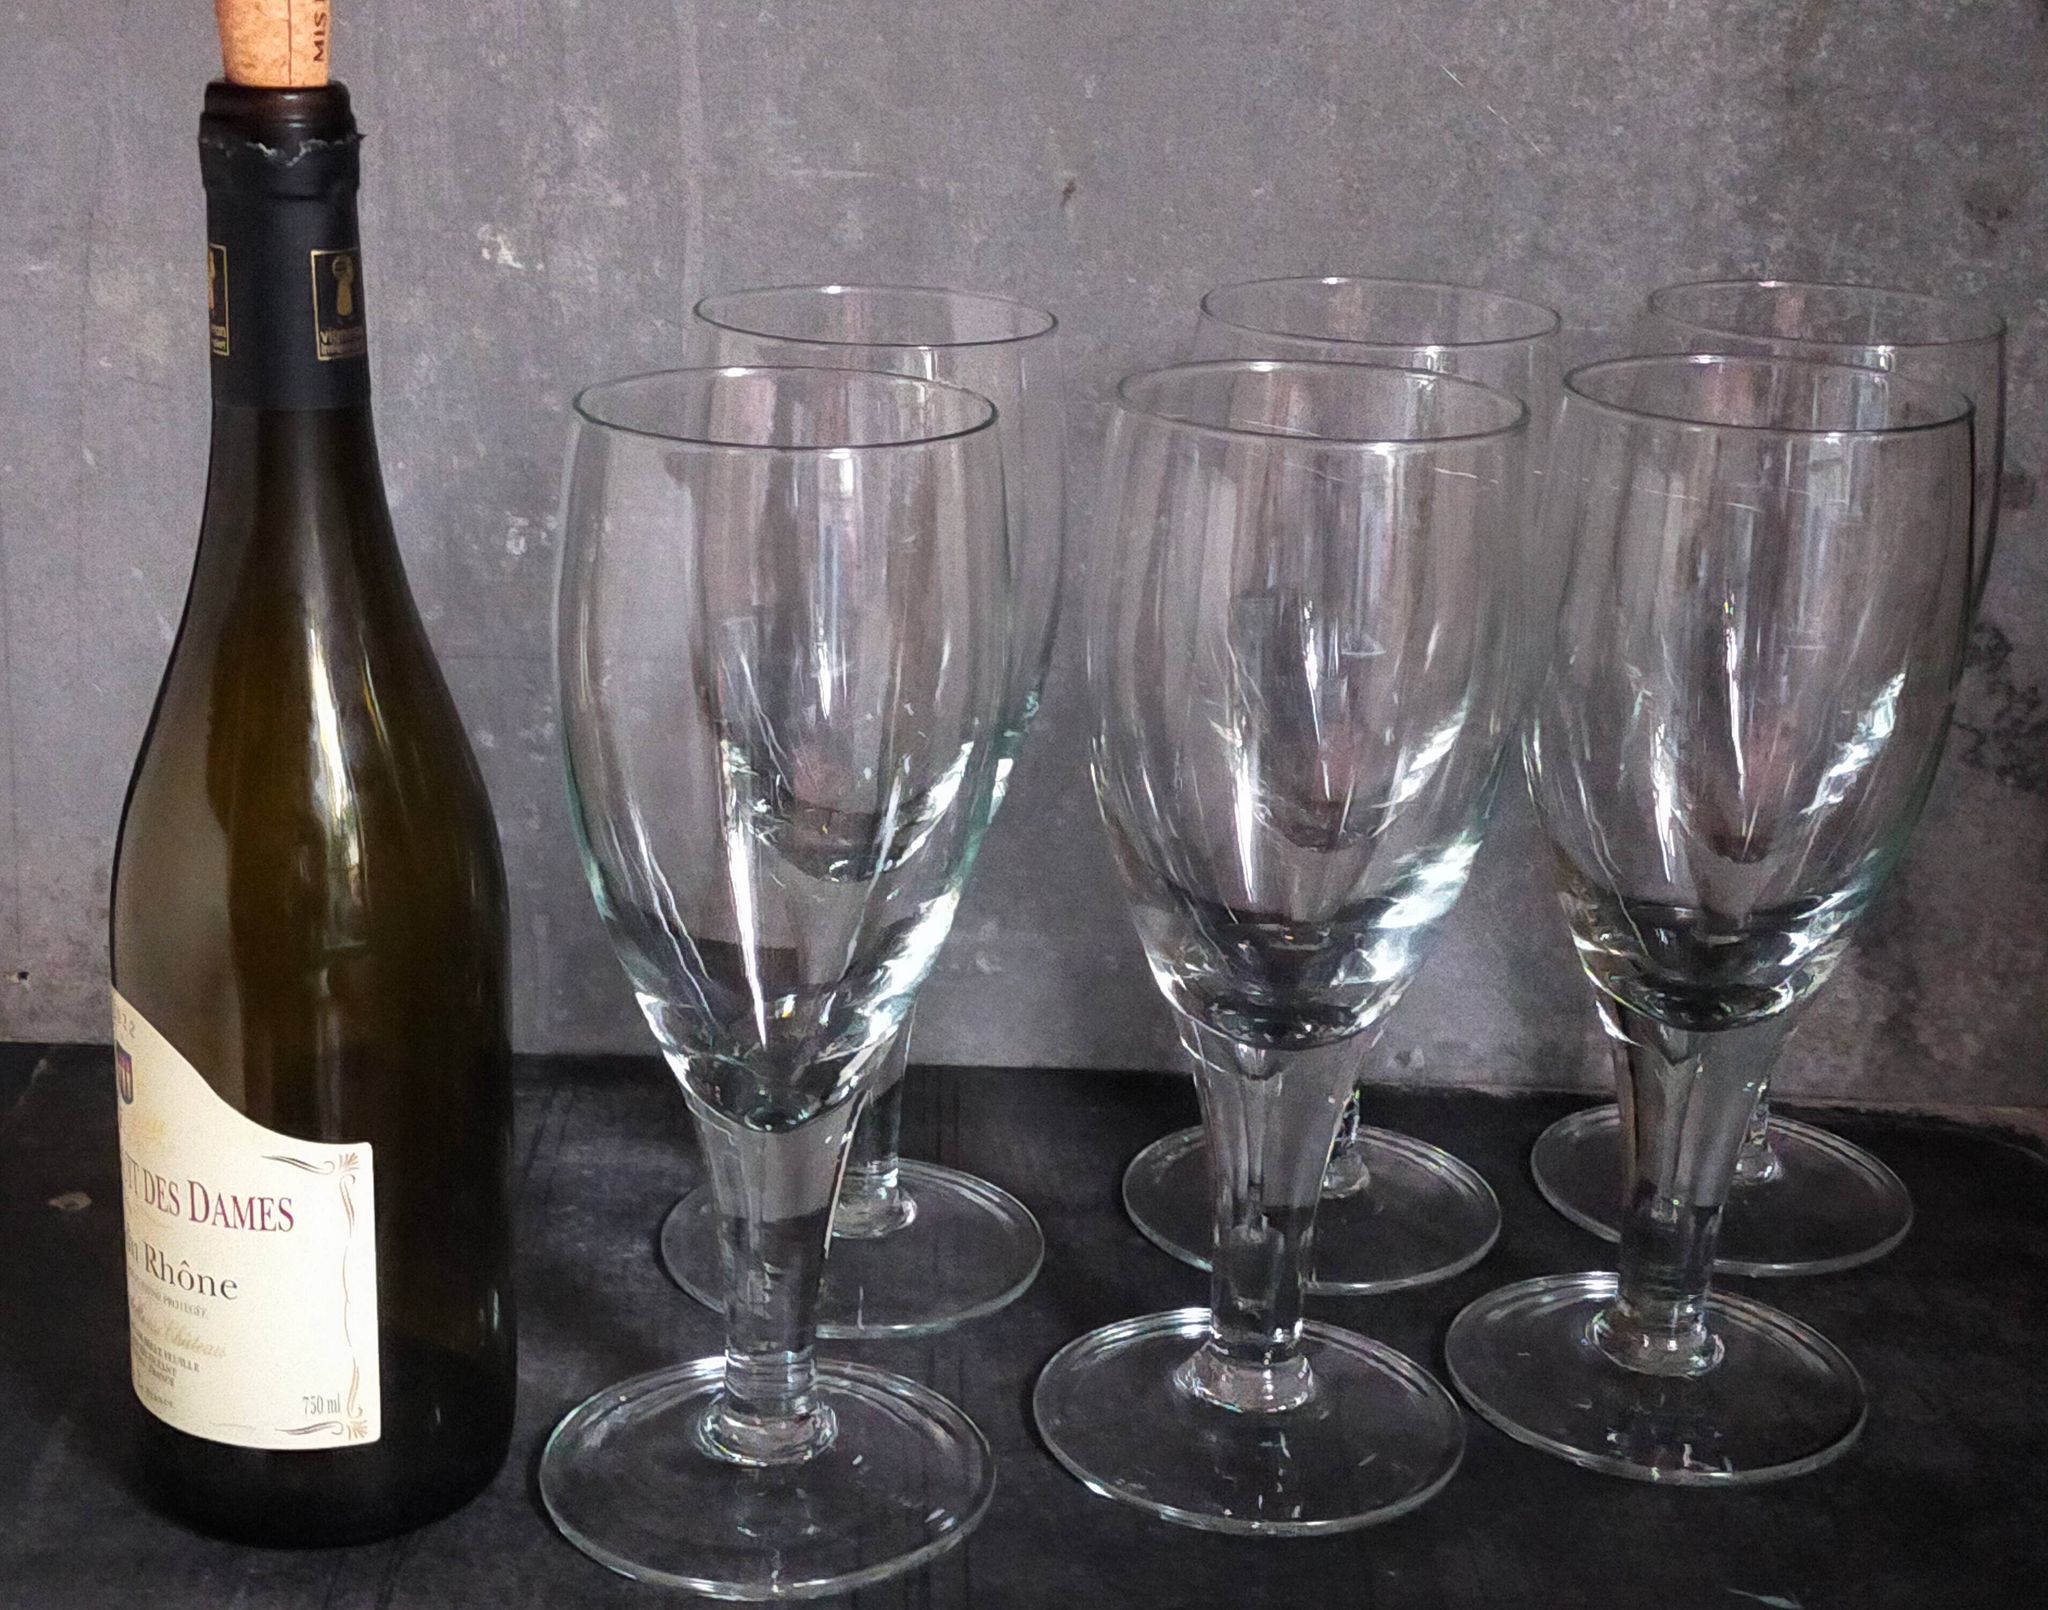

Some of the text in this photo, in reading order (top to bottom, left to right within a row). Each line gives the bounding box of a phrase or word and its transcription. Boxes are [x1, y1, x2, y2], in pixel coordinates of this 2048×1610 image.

[143, 1167, 180, 1217] DES
[187, 1179, 295, 1233] DAMES
[144, 1241, 239, 1301] Rhône
[302, 1392, 341, 1415] 750 ml
